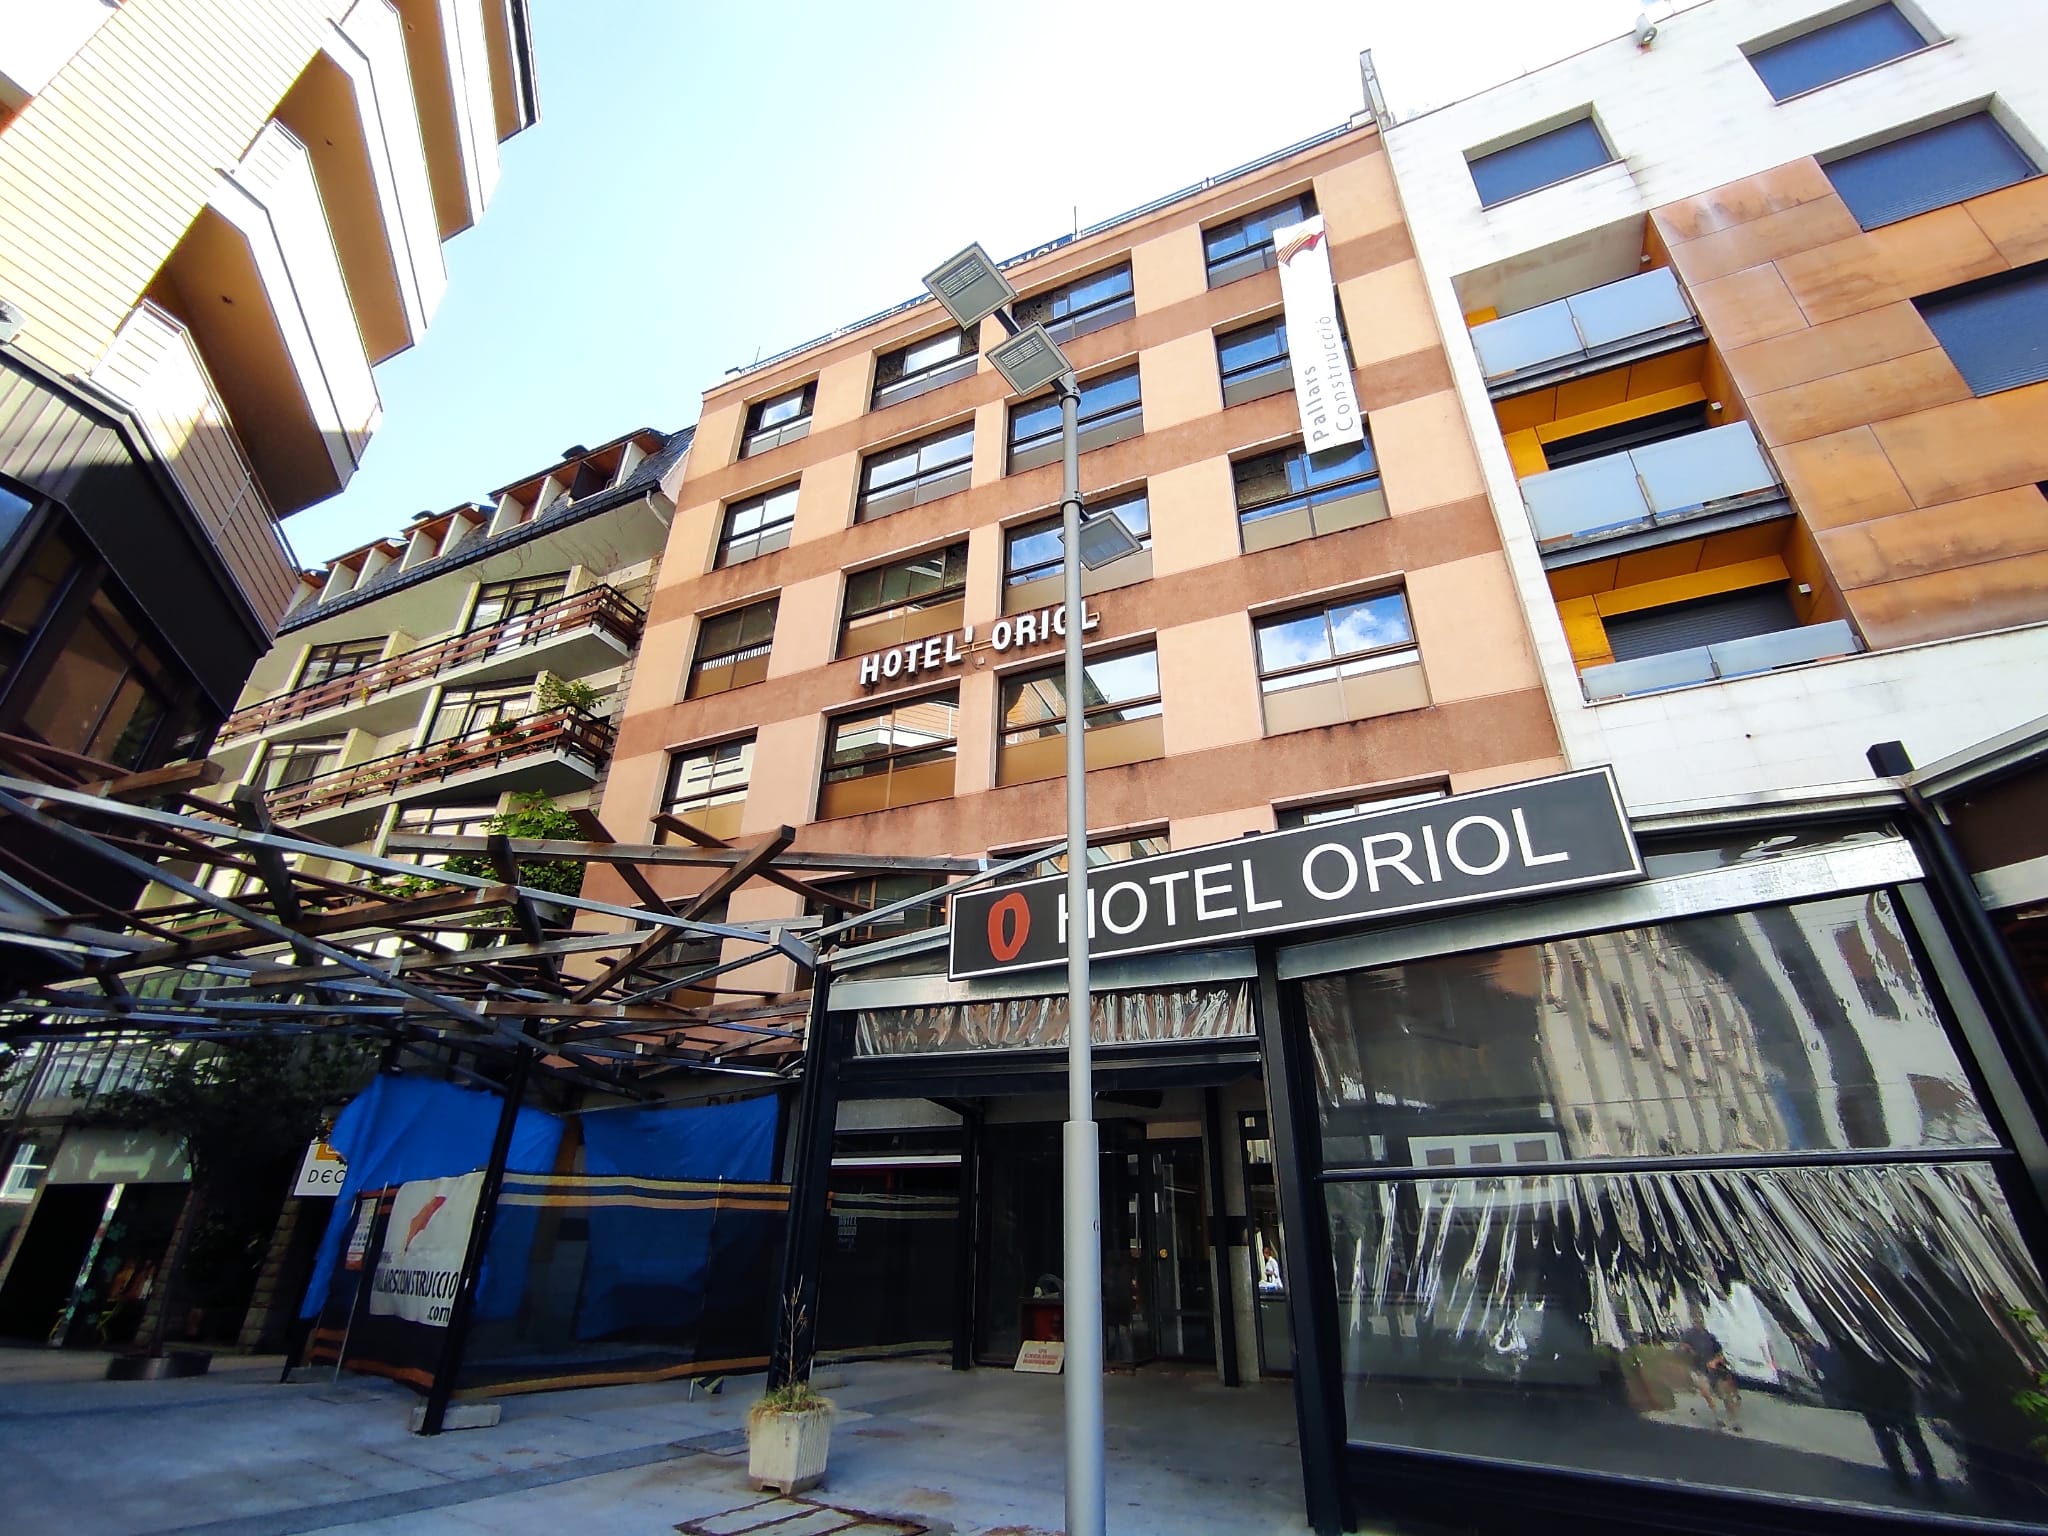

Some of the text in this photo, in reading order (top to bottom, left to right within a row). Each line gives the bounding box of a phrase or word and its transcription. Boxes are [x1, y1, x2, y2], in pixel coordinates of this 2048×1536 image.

[1304, 365, 1330, 442] Pallars
[859, 632, 966, 688] HOTEL
[1057, 858, 1284, 943] HOTEL
[1301, 806, 1570, 901] ORIOL
